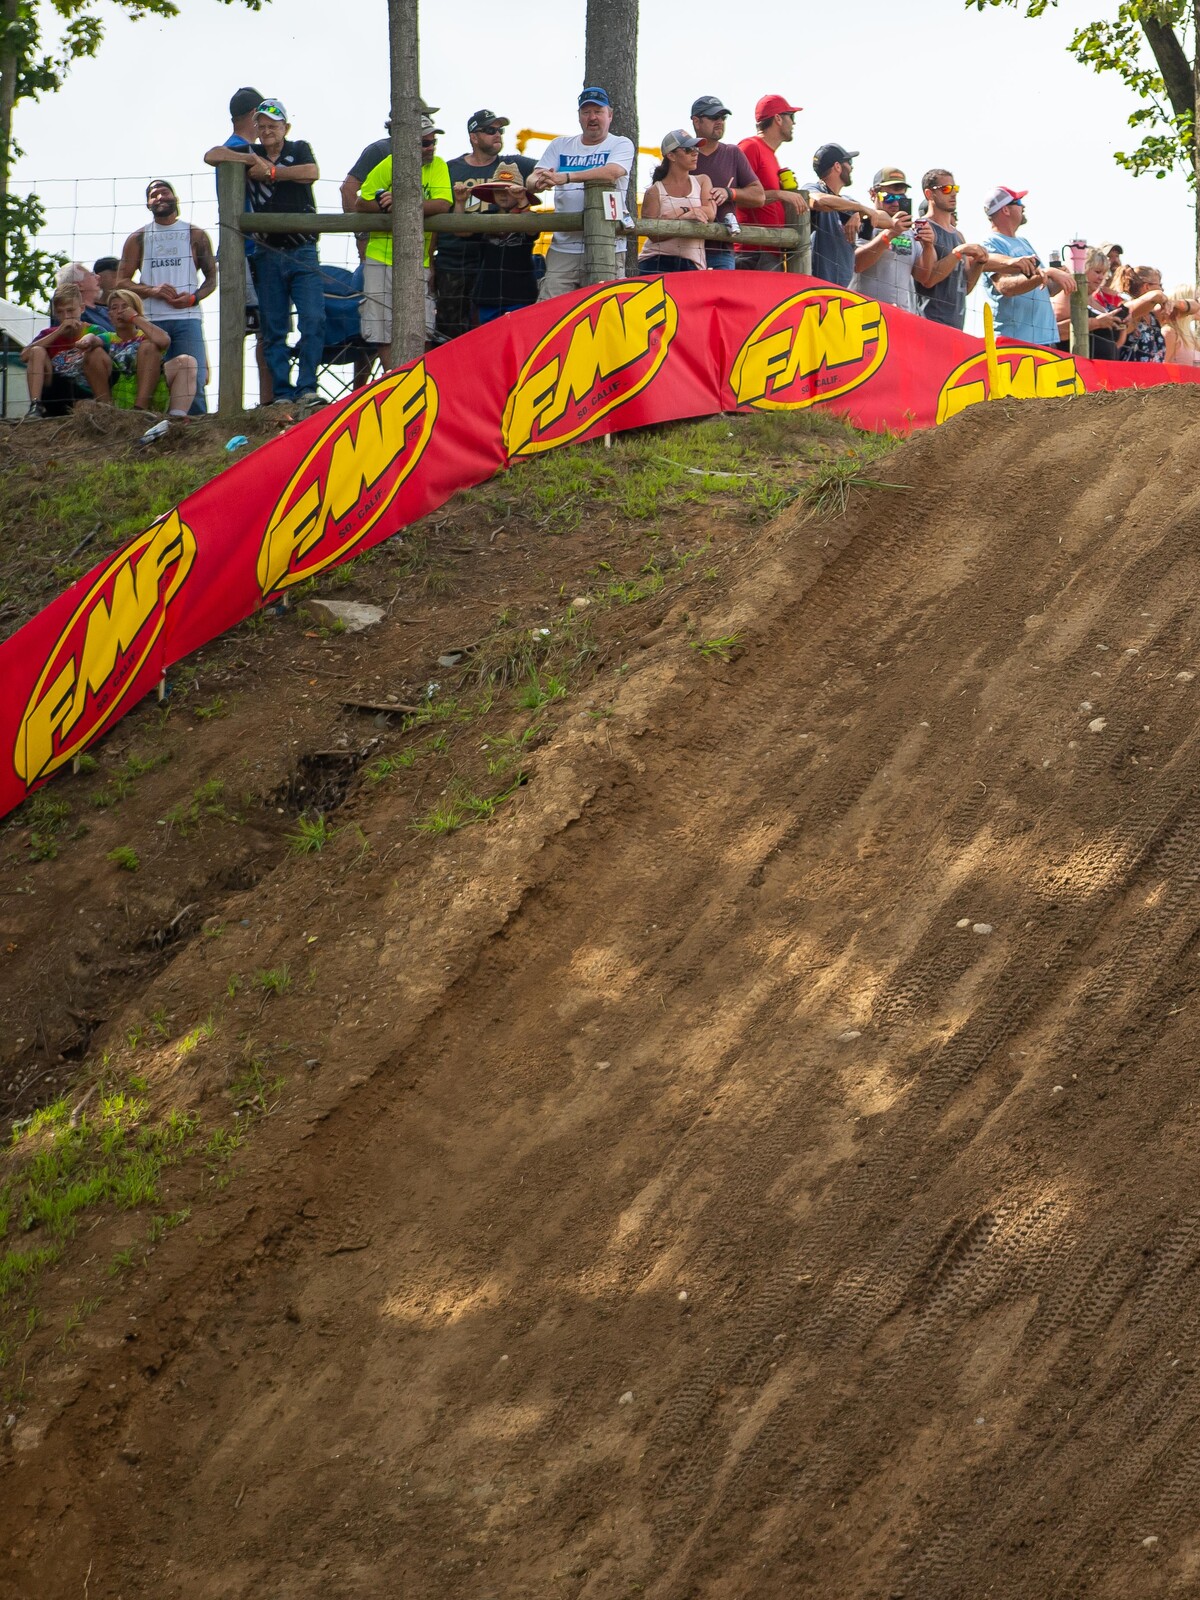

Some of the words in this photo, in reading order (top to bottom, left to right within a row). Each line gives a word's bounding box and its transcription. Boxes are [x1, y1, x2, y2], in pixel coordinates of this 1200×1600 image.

[566, 153, 606, 167] YAMAHA
[151, 258, 181, 269] CLASSIC
[508, 276, 667, 458] FMF
[736, 297, 882, 408] FMF
[261, 356, 428, 602] FMF
[26, 506, 184, 792] FMF
